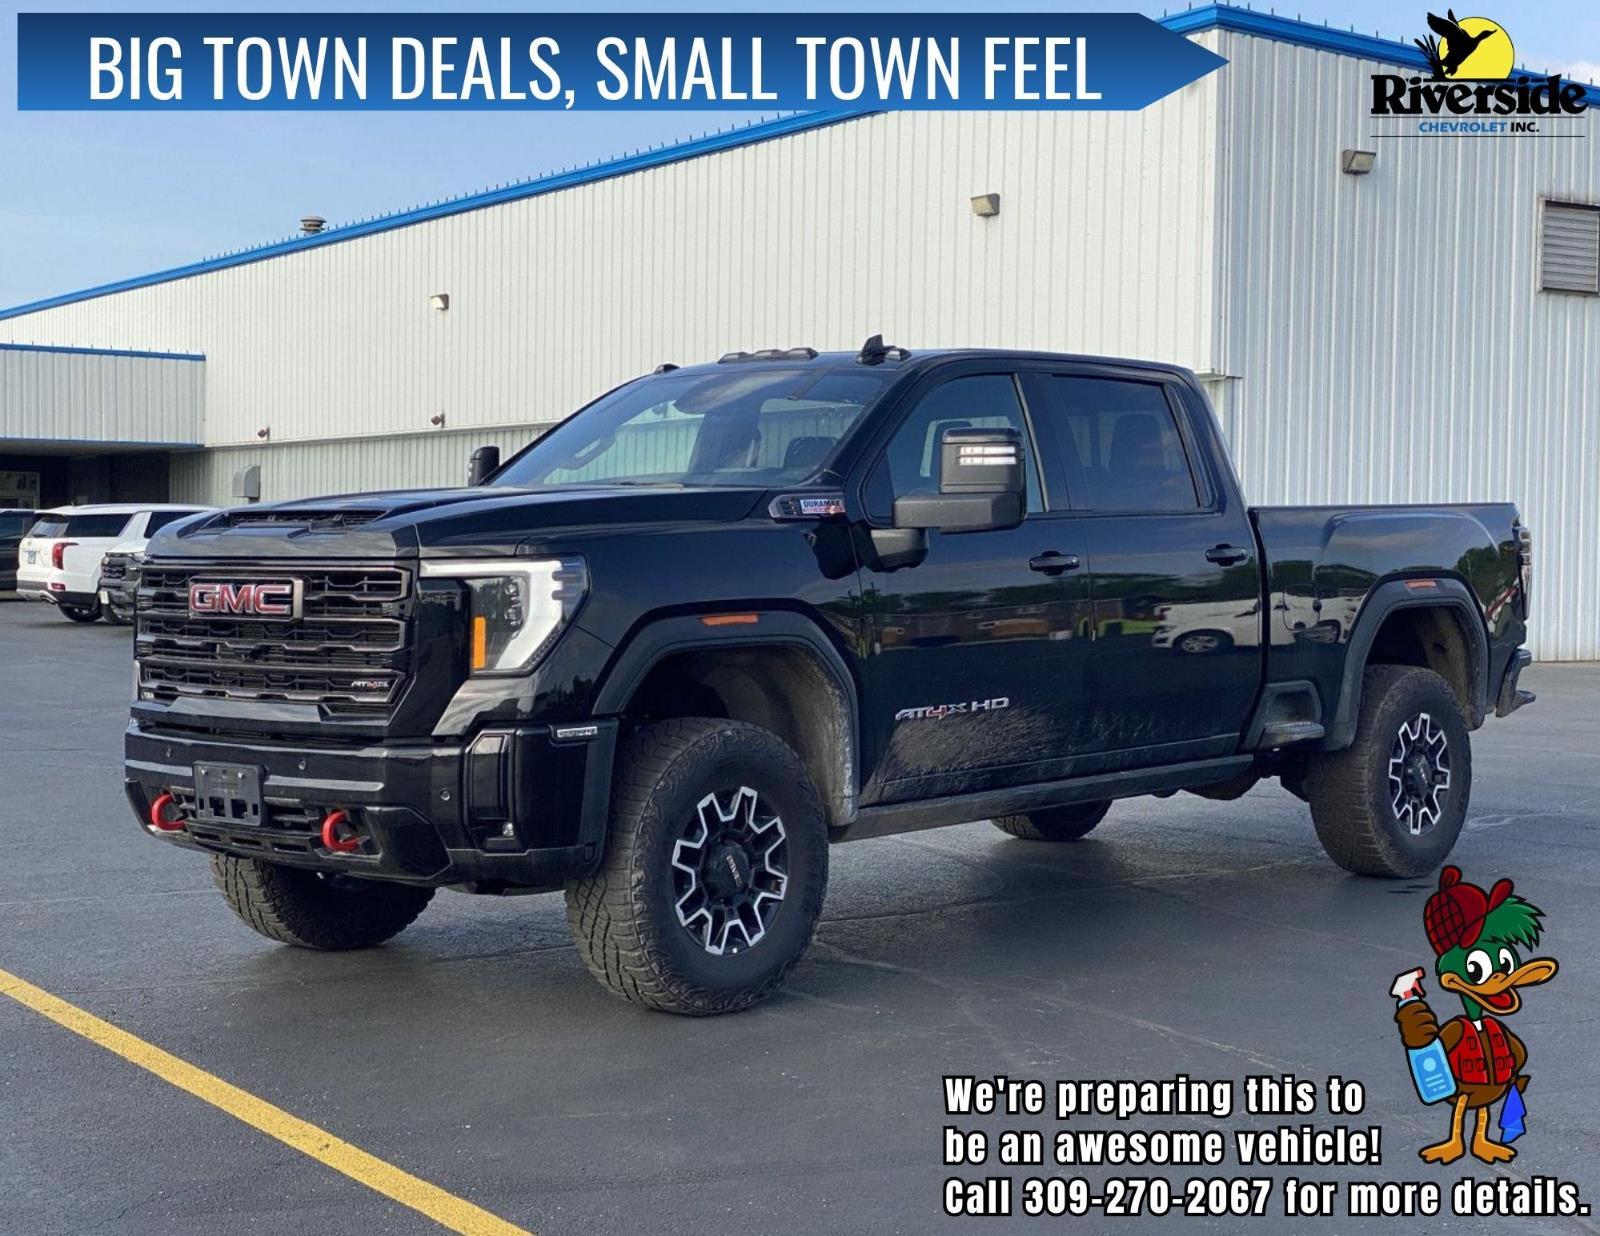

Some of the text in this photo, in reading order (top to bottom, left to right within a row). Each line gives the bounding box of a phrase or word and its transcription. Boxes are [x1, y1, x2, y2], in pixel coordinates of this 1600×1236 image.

[190, 583, 293, 615] GMC
[895, 697, 1009, 720] AT4X HD
